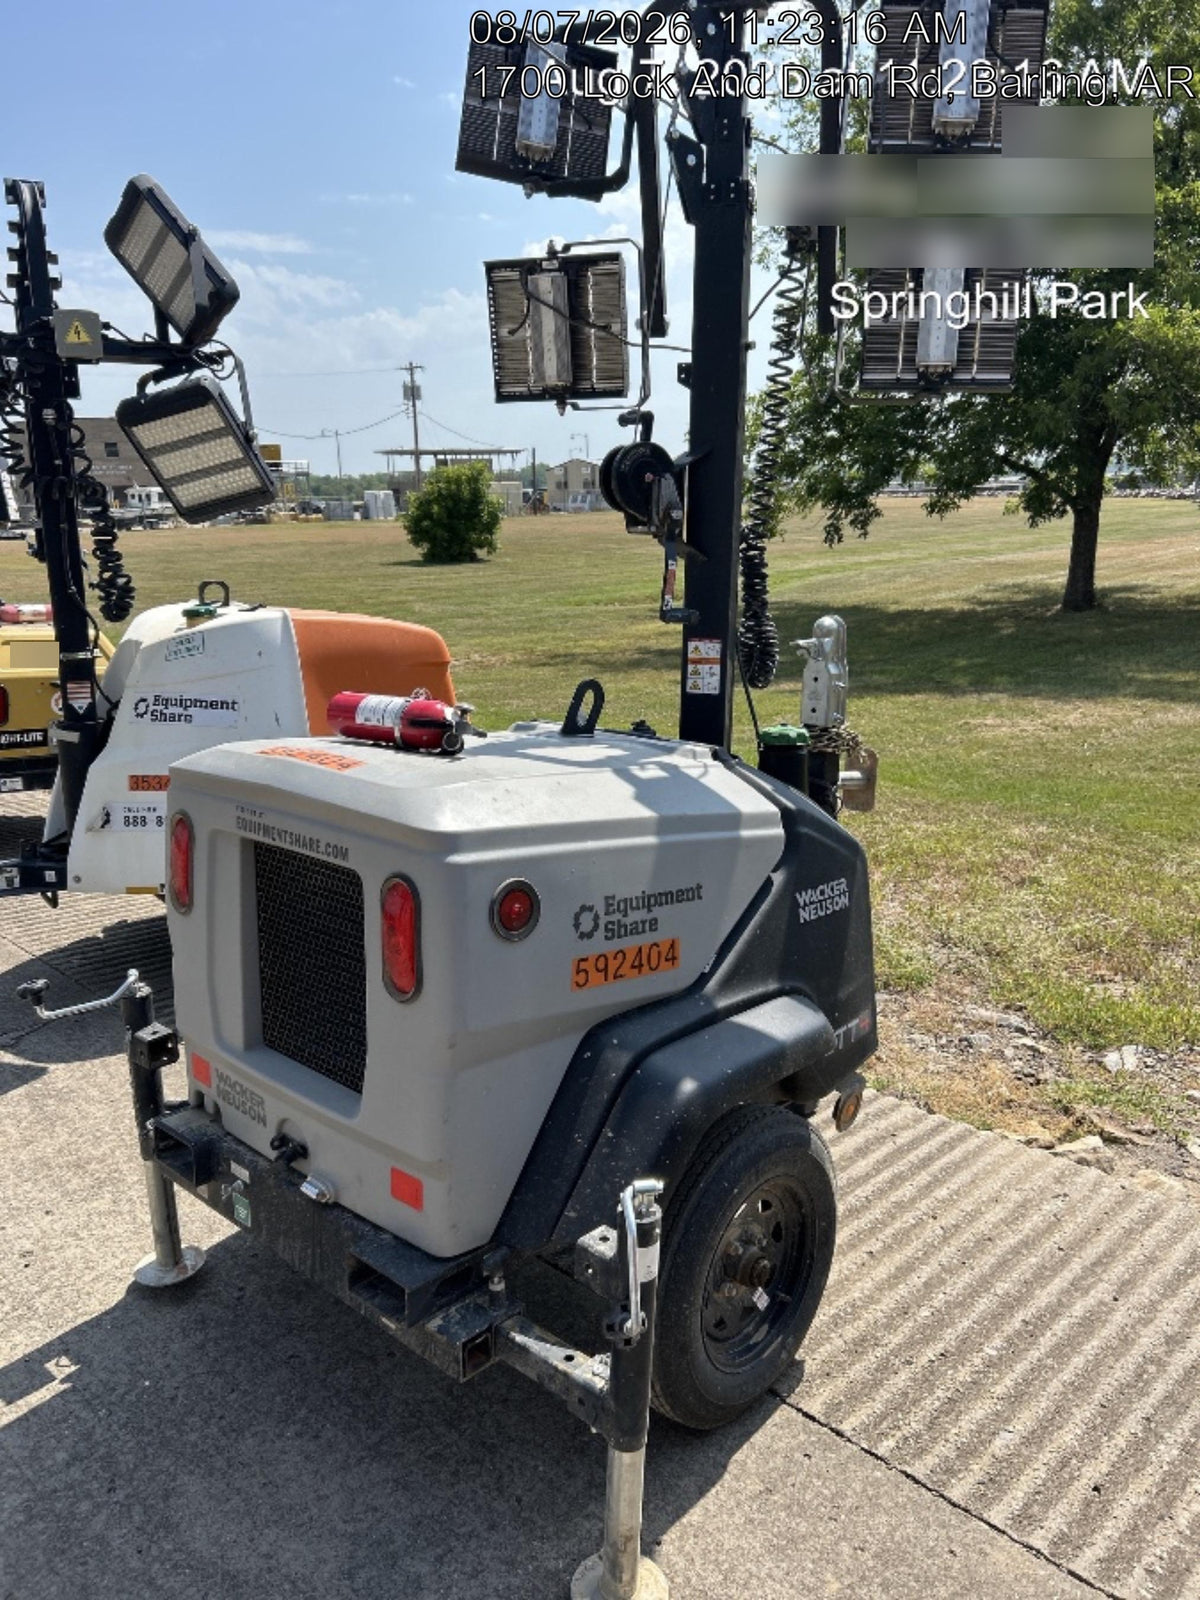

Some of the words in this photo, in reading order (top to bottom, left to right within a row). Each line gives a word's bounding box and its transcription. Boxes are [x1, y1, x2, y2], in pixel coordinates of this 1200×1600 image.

[150, 709, 193, 724] Share
[152, 695, 239, 711] Equipment
[236, 815, 349, 862] EQUIPMENTSHARE.COM
[603, 883, 703, 918] Equipment
[794, 878, 849, 907] WACKER
[799, 892, 849, 924] NEUSON
[603, 916, 659, 941] Share
[575, 939, 677, 988] 592404
